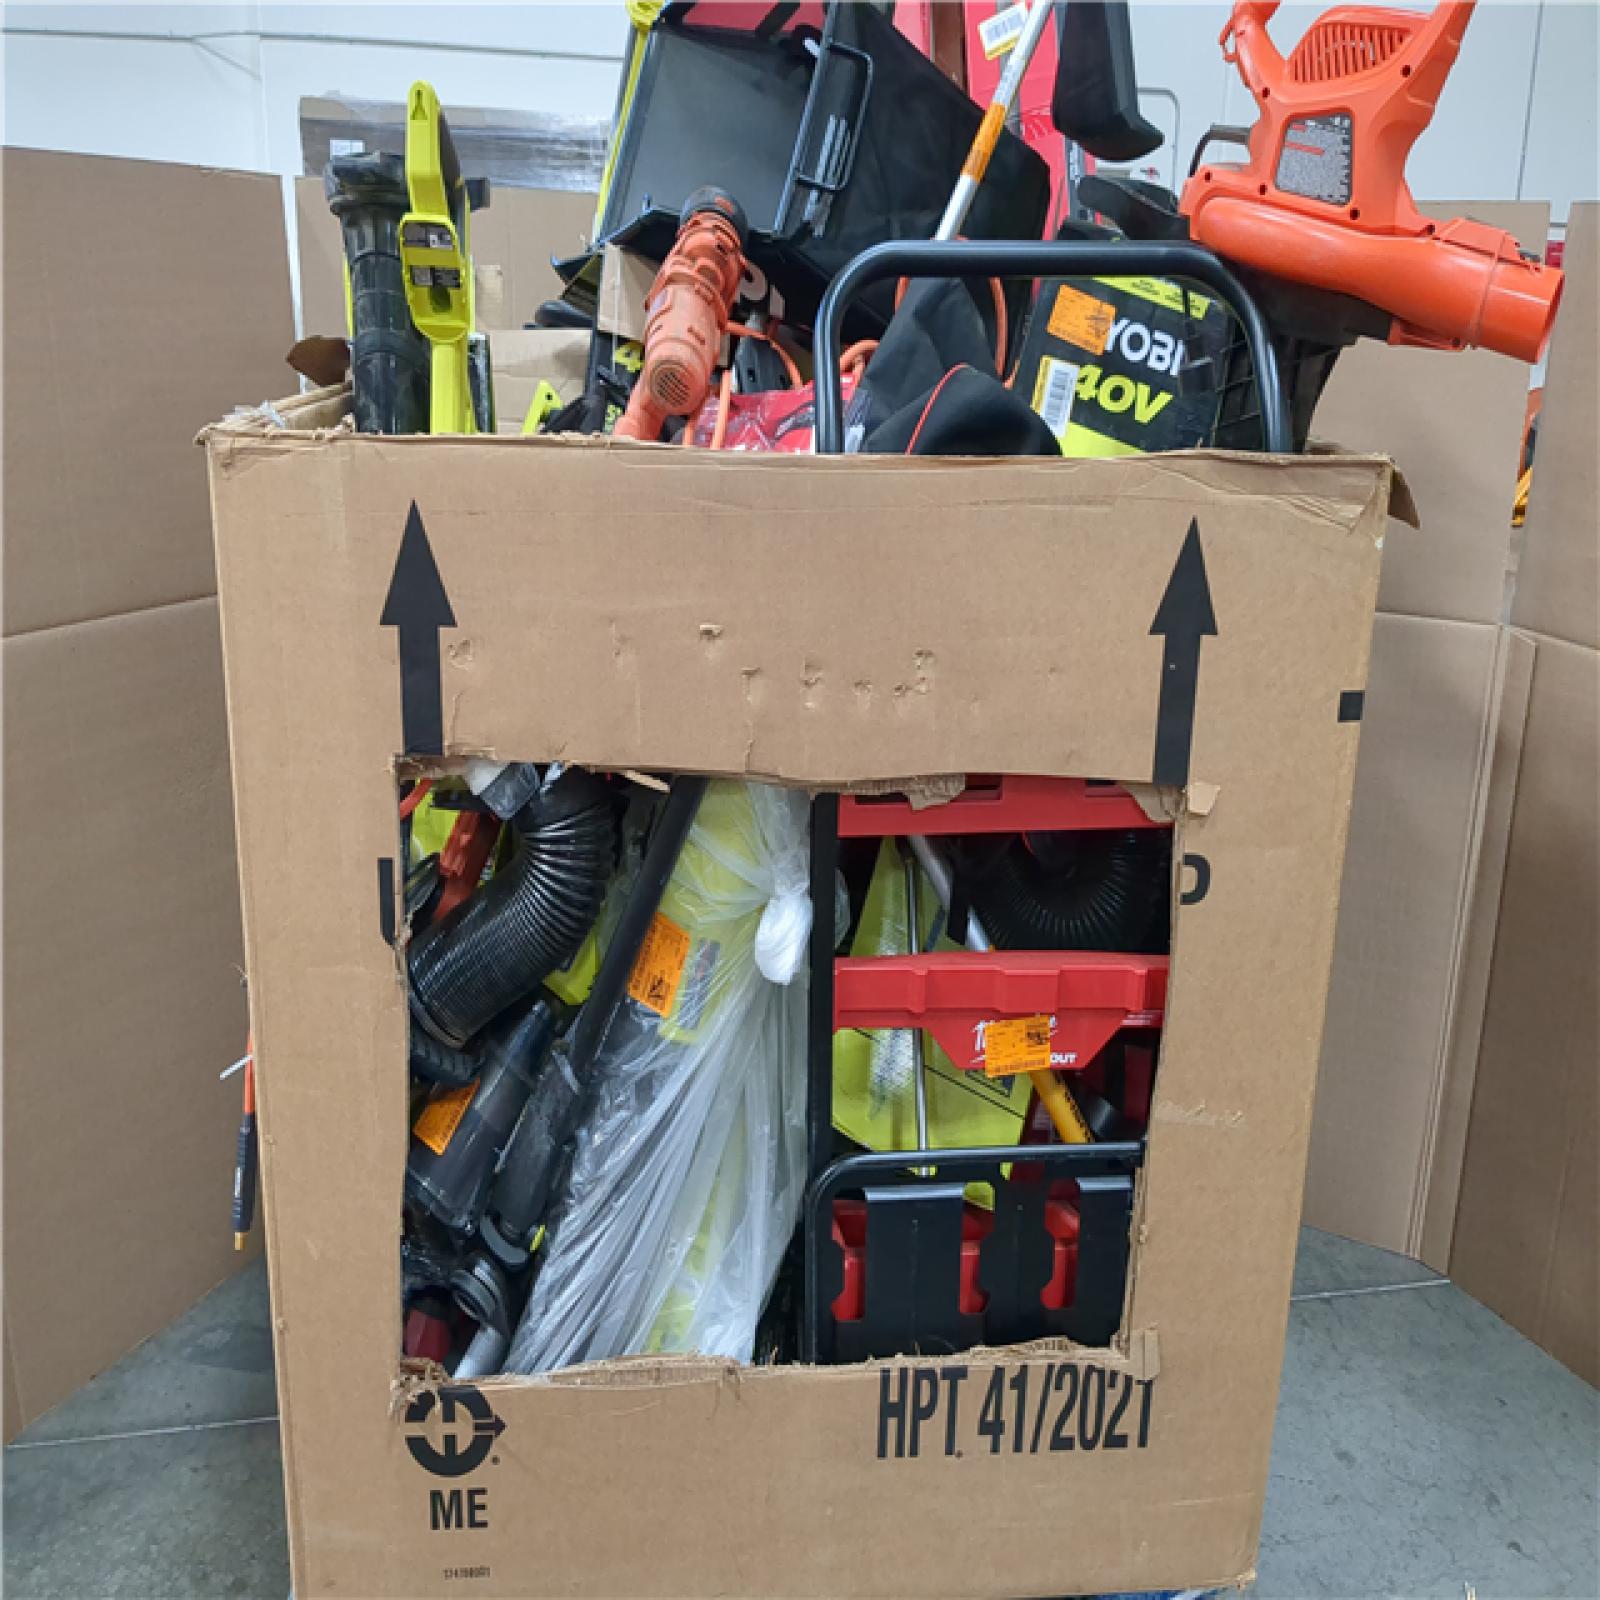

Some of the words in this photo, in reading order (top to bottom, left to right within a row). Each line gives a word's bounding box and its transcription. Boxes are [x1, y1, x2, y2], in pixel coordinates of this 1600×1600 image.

[1104, 317, 1186, 378] YOBI
[1074, 364, 1174, 424] 40V
[977, 1363, 1154, 1455] 41/2021
[429, 1487, 488, 1530] ME
